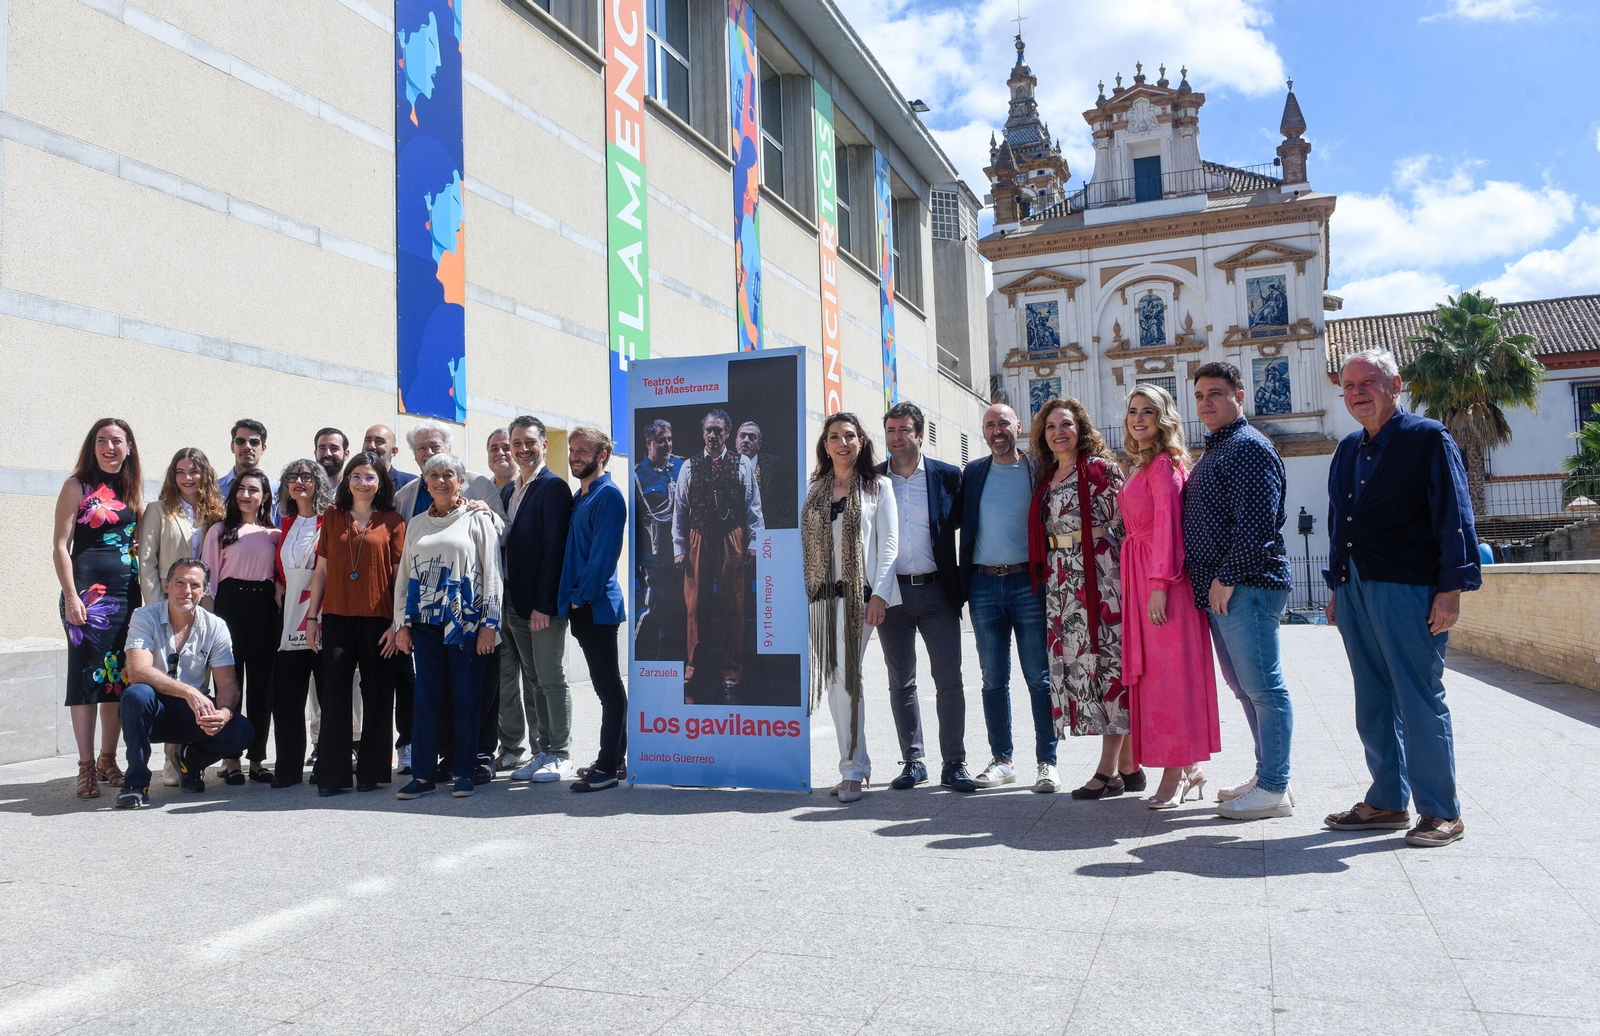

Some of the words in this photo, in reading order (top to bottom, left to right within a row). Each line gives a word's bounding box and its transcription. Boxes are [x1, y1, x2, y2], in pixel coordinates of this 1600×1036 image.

[642, 378, 671, 387] Teatro
[673, 376, 685, 385] de
[655, 387, 663, 395] la
[665, 383, 719, 395] Maestranza
[763, 536, 772, 559] 20h.
[764, 575, 774, 604] mayo
[763, 605, 773, 619] de
[764, 621, 772, 630] 11
[765, 631, 774, 639] y
[764, 640, 773, 648] 9
[638, 667, 678, 678] Zarzuela
[640, 711, 680, 734] Los
[685, 713, 801, 740] gavilanes
[638, 752, 671, 763] Jacinto
[673, 753, 715, 764] Guerrero
